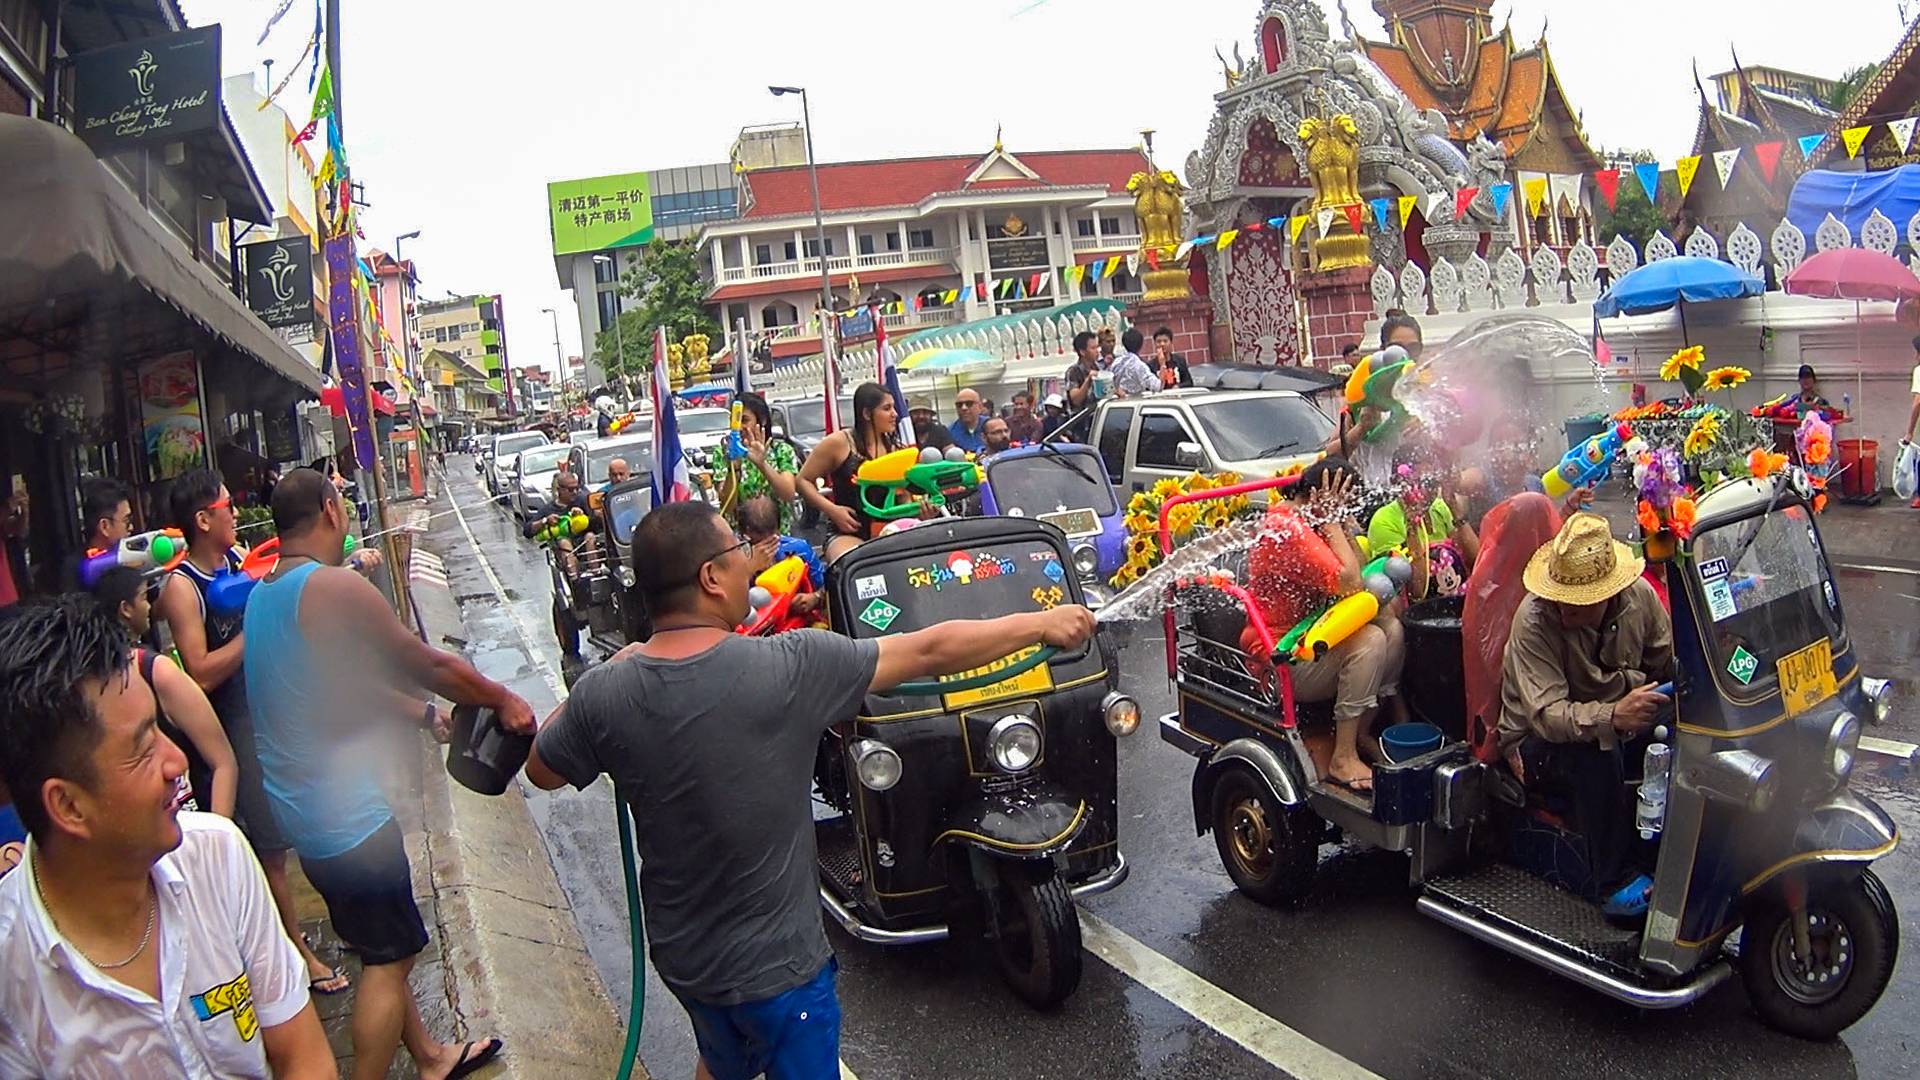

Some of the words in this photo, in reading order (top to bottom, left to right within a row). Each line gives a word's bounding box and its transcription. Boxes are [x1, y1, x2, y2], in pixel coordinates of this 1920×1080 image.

[172, 90, 208, 110] Hotel
[558, 189, 644, 213] 清迈第一平价
[574, 207, 632, 228] 特产商场
[907, 563, 953, 592] วัยรุ่น
[867, 606, 893, 621] LPG
[1732, 656, 1754, 673] LPG
